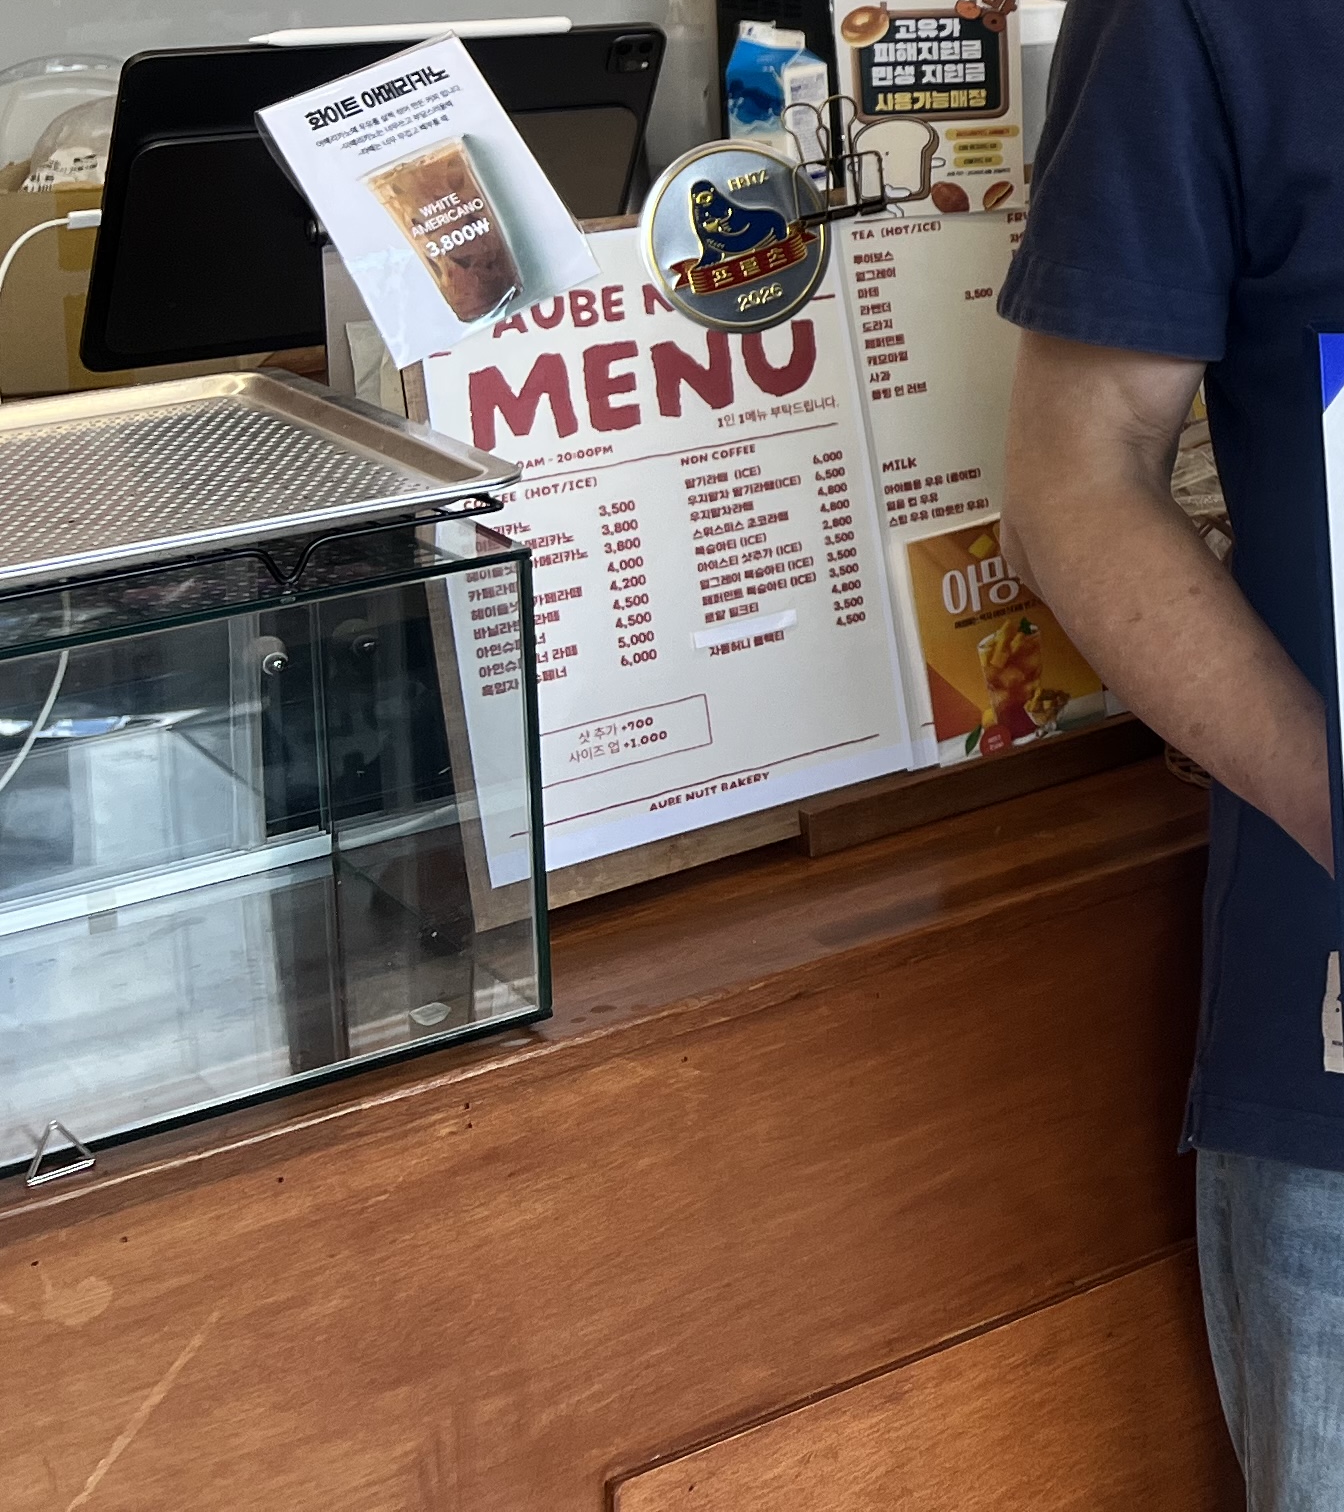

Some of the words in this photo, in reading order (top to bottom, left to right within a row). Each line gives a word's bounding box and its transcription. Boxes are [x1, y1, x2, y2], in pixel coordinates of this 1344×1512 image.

[895, 18, 960, 39] 고유가
[874, 40, 982, 63] 피해지원금
[872, 65, 915, 87] 민생
[921, 62, 985, 84] 지원금
[305, 96, 363, 130] 화이트
[361, 66, 449, 108] 아메리카노
[875, 89, 987, 111] 사용가능매장
[419, 193, 460, 217] WHITE
[411, 198, 484, 238] AMERICANO
[852, 230, 874, 240] TEA
[881, 221, 942, 238] (HOT/ICE)
[493, 285, 625, 338] AUBE
[469, 319, 816, 451] MENU
[718, 415, 735, 427] 1인
[739, 409, 768, 424] 1메뉴
[771, 395, 839, 418] 부탁드립니다.
[681, 453, 708, 466] NON
[712, 444, 756, 460] COFFEE
[883, 457, 917, 472] MILK
[735, 465, 761, 480] (ICE)
[525, 477, 597, 498] (HOT/ICE)
[741, 533, 766, 548] (ICE)
[776, 542, 802, 556] (ICE)
[579, 731, 590, 744] 샷
[594, 723, 617, 740] 추가
[622, 717, 654, 731] +700
[569, 747, 605, 763] 사이즈
[608, 741, 620, 753] 업
[649, 796, 682, 811] AUBE
[686, 786, 717, 801] NUIT
[722, 772, 769, 792] BAKERY
